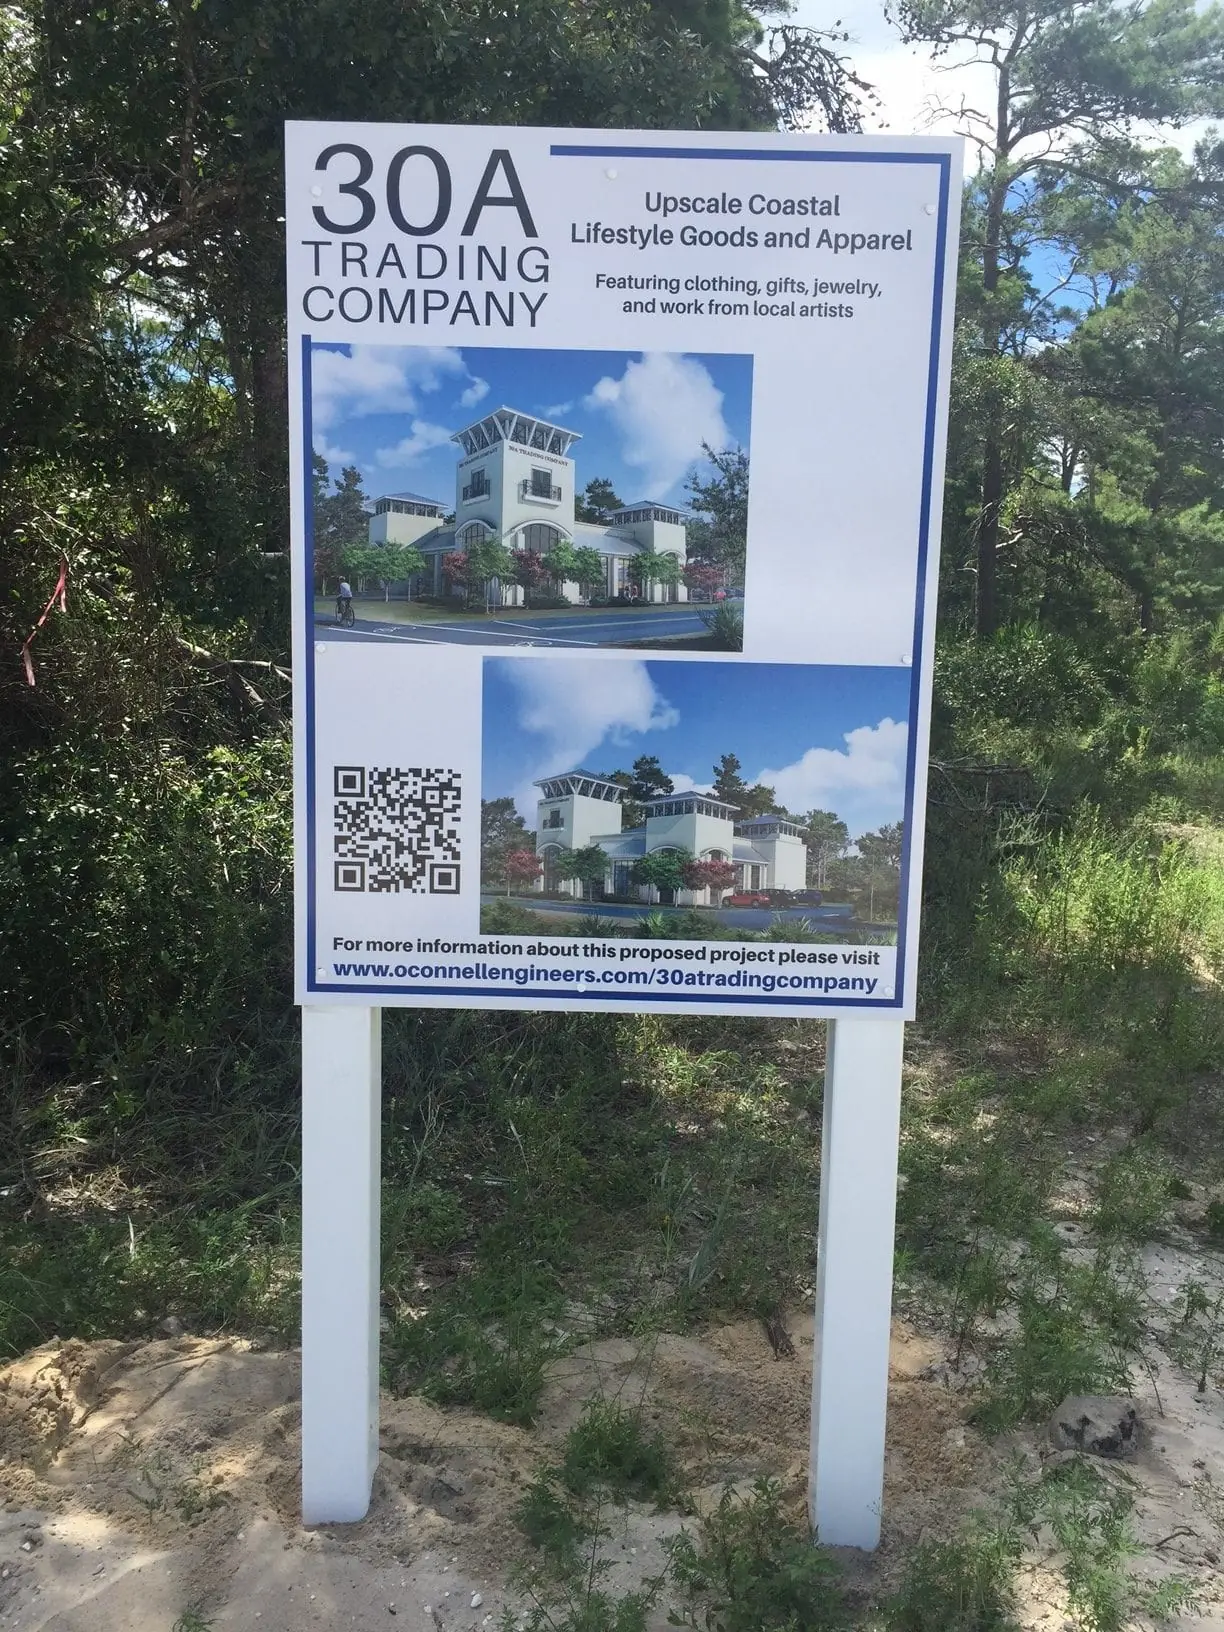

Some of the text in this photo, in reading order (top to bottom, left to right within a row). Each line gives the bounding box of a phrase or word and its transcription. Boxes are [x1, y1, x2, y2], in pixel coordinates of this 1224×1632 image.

[312, 143, 538, 237] 30A
[645, 192, 840, 217] Upscale Coastal
[571, 221, 913, 254] Lifestyle Goods and Apparel
[302, 241, 548, 282] TRADING
[596, 273, 882, 299] Featuring clothing, gifts, jewelry,
[303, 286, 548, 327] COMPANY
[622, 298, 853, 318] and work from local artists
[333, 936, 880, 966] For more information about this proposed project please visit
[333, 962, 879, 995] www.oconnellengineers.com/30atradingcompany
